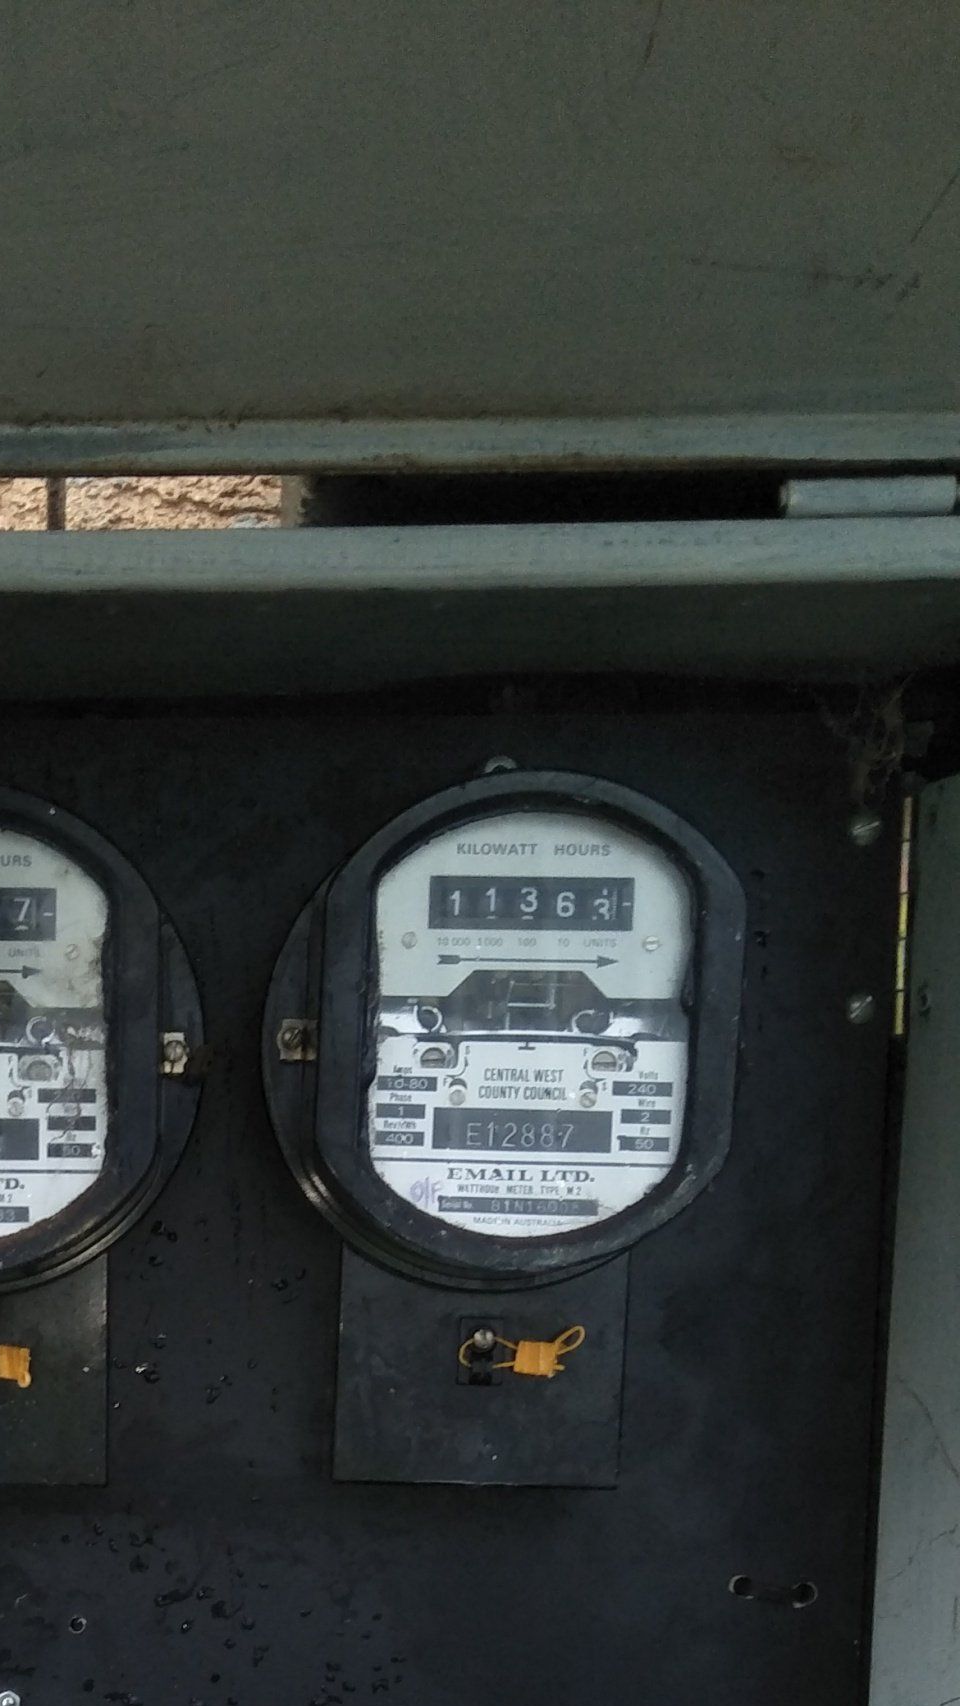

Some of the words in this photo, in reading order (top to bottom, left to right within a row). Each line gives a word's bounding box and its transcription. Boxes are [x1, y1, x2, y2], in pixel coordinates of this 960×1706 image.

[457, 843, 537, 856] KILOWATT
[554, 844, 611, 857] HOURS
[484, 1068, 530, 1082] CENTRAL
[534, 1069, 565, 1083] WEST
[478, 1085, 521, 1099] COUNTY
[523, 1086, 567, 1100] COUNCIL
[628, 1084, 657, 1095] 240
[641, 1112, 650, 1122] 2
[385, 1134, 414, 1144] 400
[466, 1121, 574, 1148] E12887
[634, 1139, 654, 1150] 50
[447, 1168, 533, 1182] EMAIL
[540, 1169, 595, 1182] LTD.
[506, 1185, 533, 1194] METER
